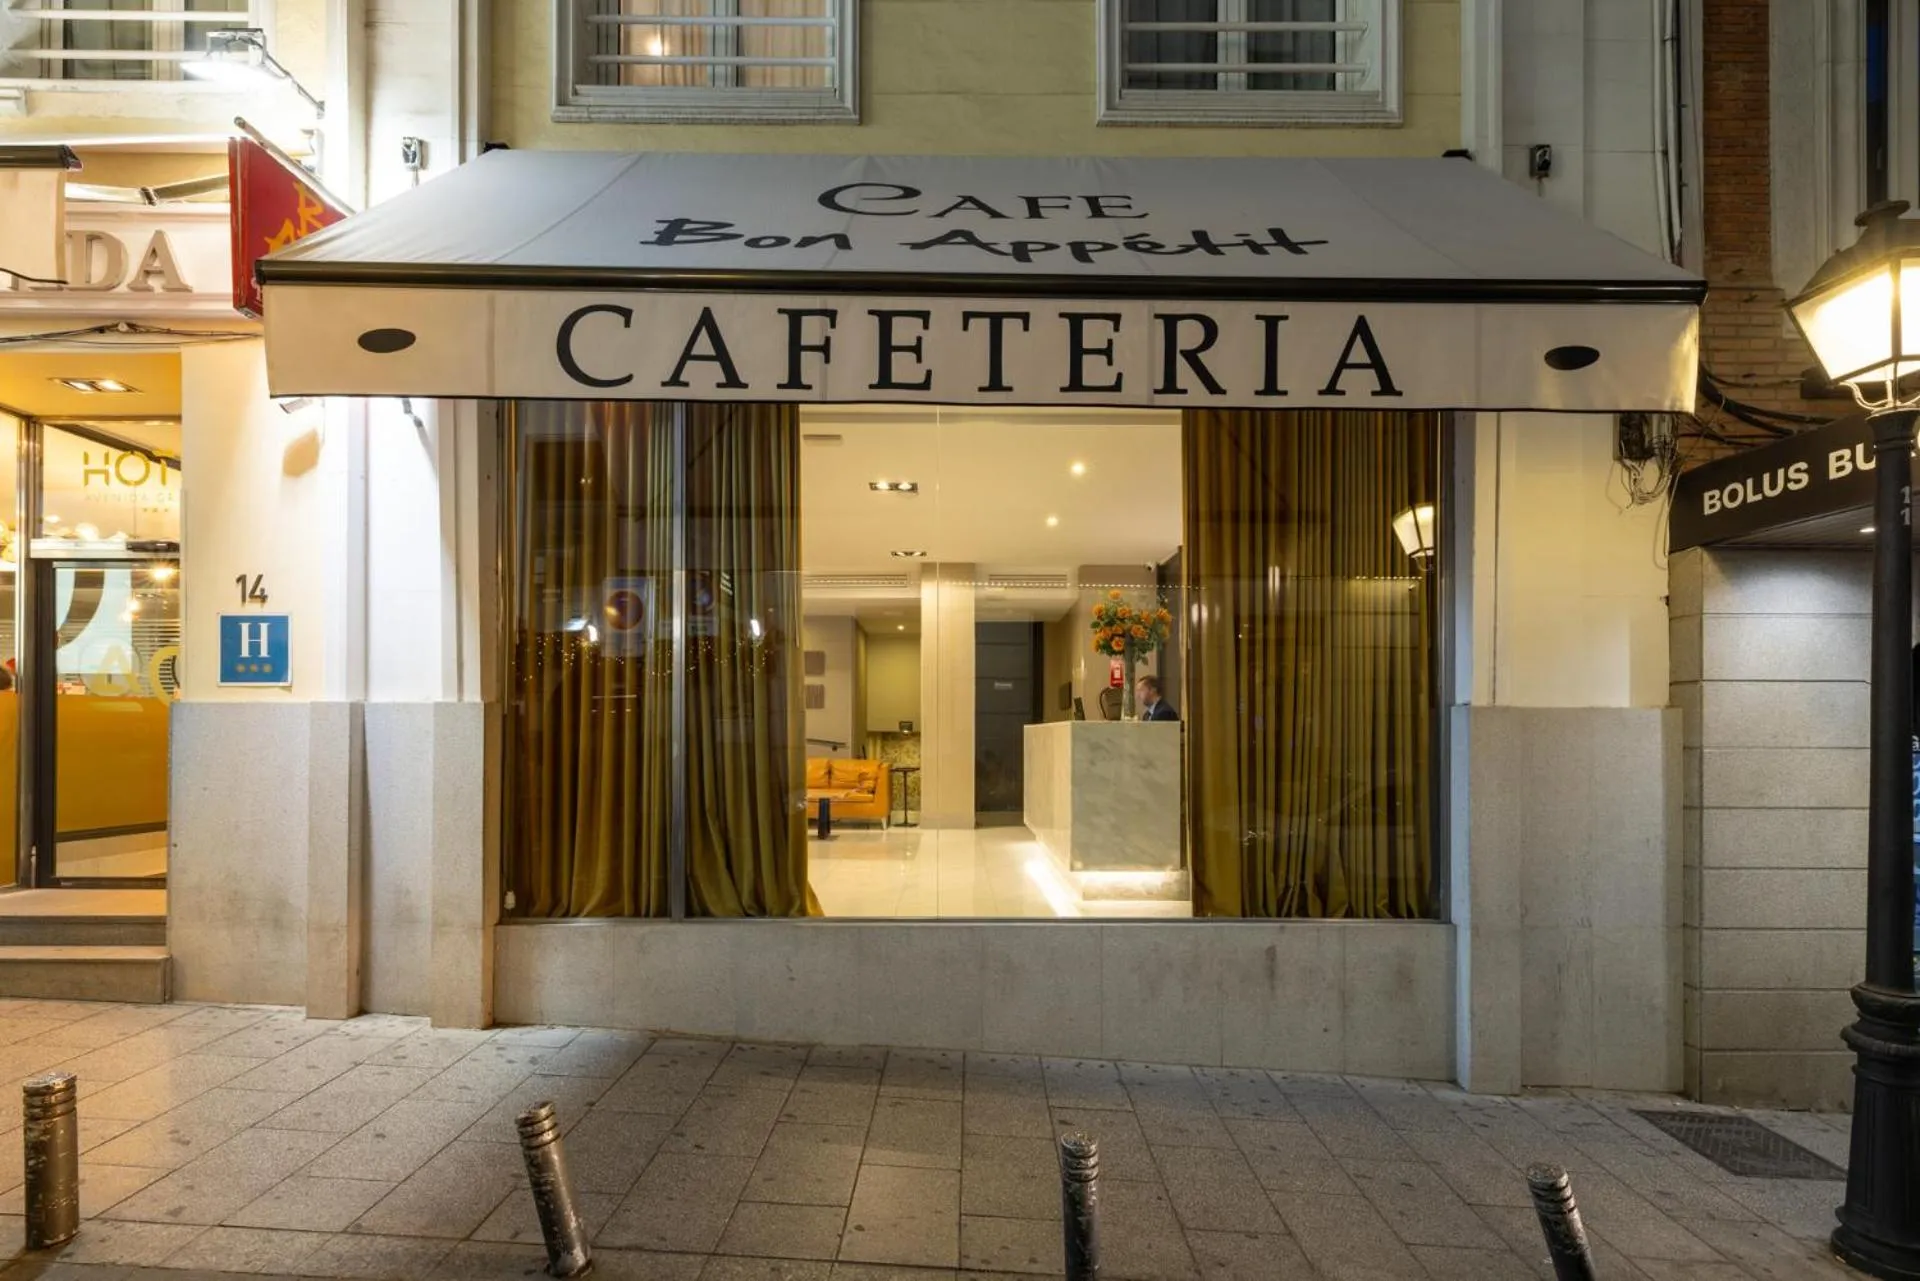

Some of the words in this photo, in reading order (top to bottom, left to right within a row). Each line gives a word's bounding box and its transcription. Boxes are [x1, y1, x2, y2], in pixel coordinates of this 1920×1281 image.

[640, 219, 853, 251] Bon
[899, 228, 1329, 264] Appétit
[557, 304, 1404, 397] CAFETERIA
[1703, 461, 1809, 516] BOLUS
[235, 574, 268, 604] 14
[239, 622, 270, 658] H
